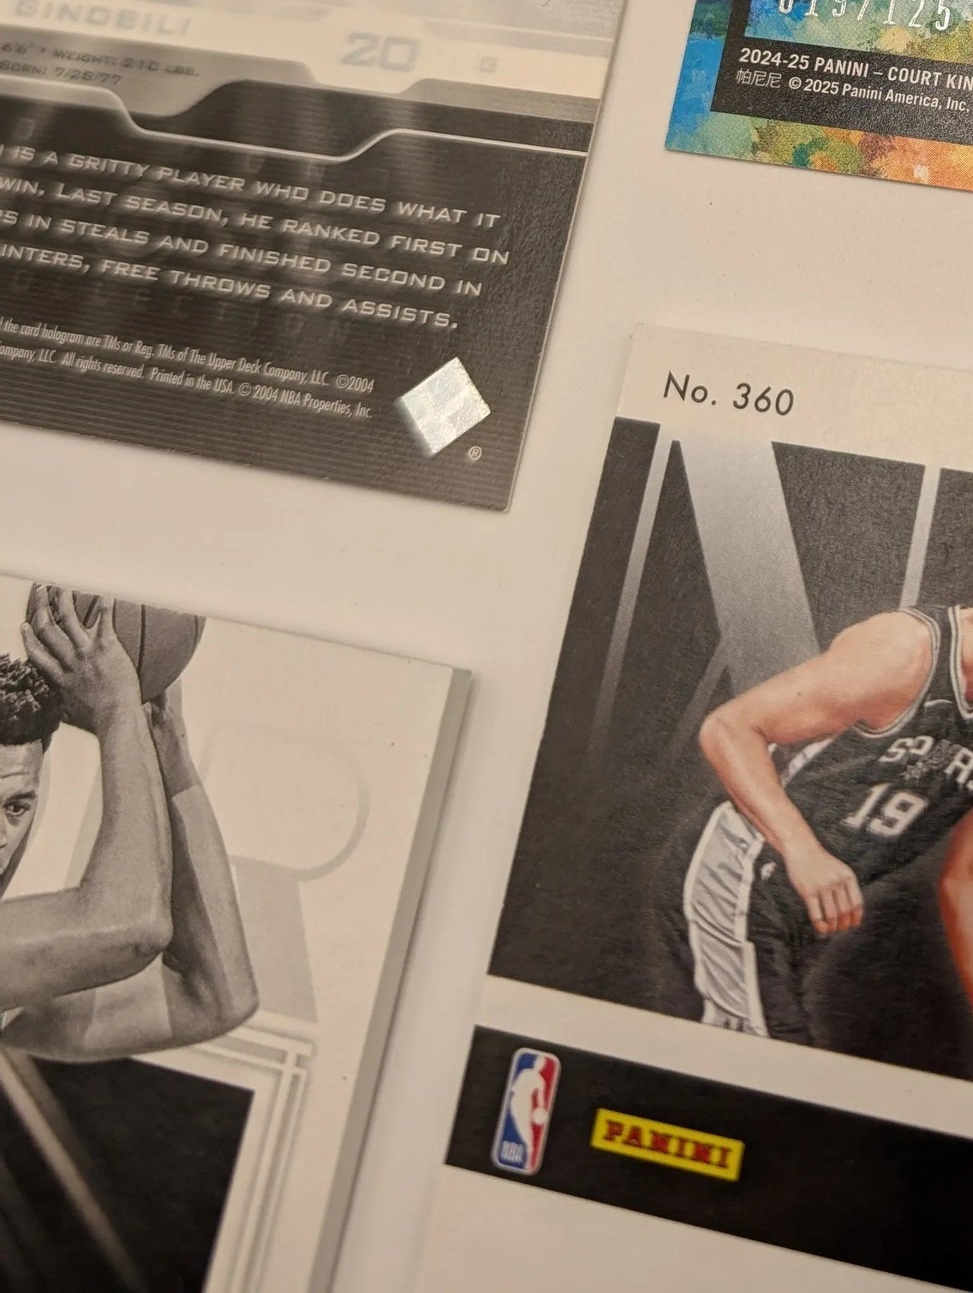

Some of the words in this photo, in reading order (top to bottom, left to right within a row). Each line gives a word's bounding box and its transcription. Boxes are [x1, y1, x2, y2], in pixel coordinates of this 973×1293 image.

[340, 32, 420, 72] 20
[738, 48, 810, 71] 2024-25
[814, 57, 869, 79] PANINI
[887, 66, 941, 87] COURT
[735, 69, 782, 89] 帕尼尼
[804, 78, 839, 96] 2025
[842, 82, 883, 101] Panini
[884, 87, 940, 110] America,
[946, 96, 971, 113] Inc.
[69, 154, 150, 177] GRITTY
[158, 167, 246, 191] PLAYER
[256, 180, 309, 202] WHO
[319, 190, 387, 213] DOES
[398, 201, 467, 224] WHAT
[477, 213, 501, 228] IT
[56, 183, 118, 207] LAST
[126, 195, 229, 227] SEASON,
[241, 212, 274, 229] HE
[283, 218, 380, 246] RANKED
[391, 235, 463, 258] FIRST
[472, 246, 510, 265] ON
[61, 219, 150, 244] STEALS
[159, 235, 209, 254] AND
[219, 244, 332, 273] FINISHED
[342, 262, 445, 291] SECOND
[455, 280, 483, 297] IN
[101, 259, 161, 281] FREE
[170, 269, 272, 300] THROWS
[280, 288, 333, 309] AND
[342, 299, 459, 329] ASSISTS.
[208, 352, 236, 371] Upper
[238, 358, 261, 375] Deck
[264, 364, 308, 385] Company,
[303, 393, 353, 416] Properties,
[355, 402, 373, 419] Inc.
[663, 370, 717, 406] No.
[733, 382, 794, 416] 360
[839, 783, 929, 838] 19
[604, 1119, 733, 1170] PANINI
